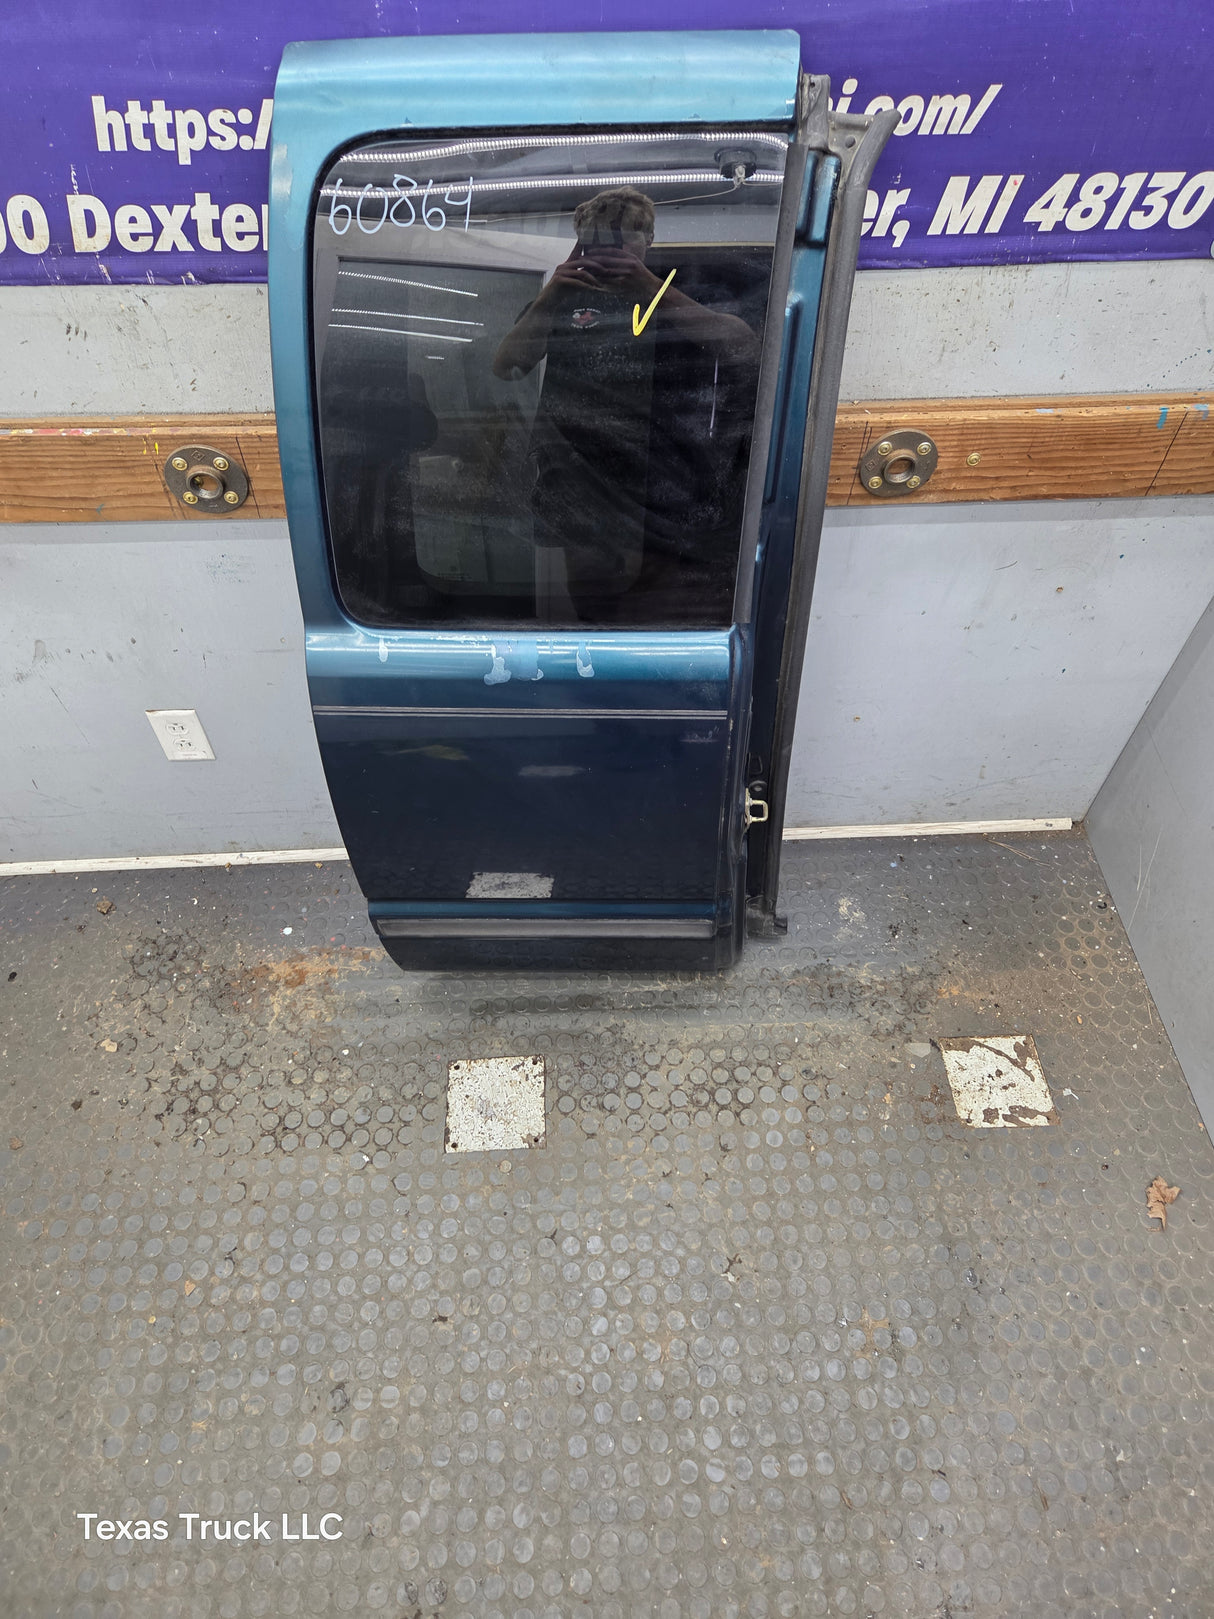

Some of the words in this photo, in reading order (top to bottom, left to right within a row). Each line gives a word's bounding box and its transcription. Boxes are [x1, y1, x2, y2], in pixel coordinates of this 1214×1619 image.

[91, 95, 274, 165] https:/
[0, 193, 50, 255] 0
[927, 174, 1025, 236] MI
[1022, 170, 1214, 232] 48130
[328, 173, 474, 236] 60864
